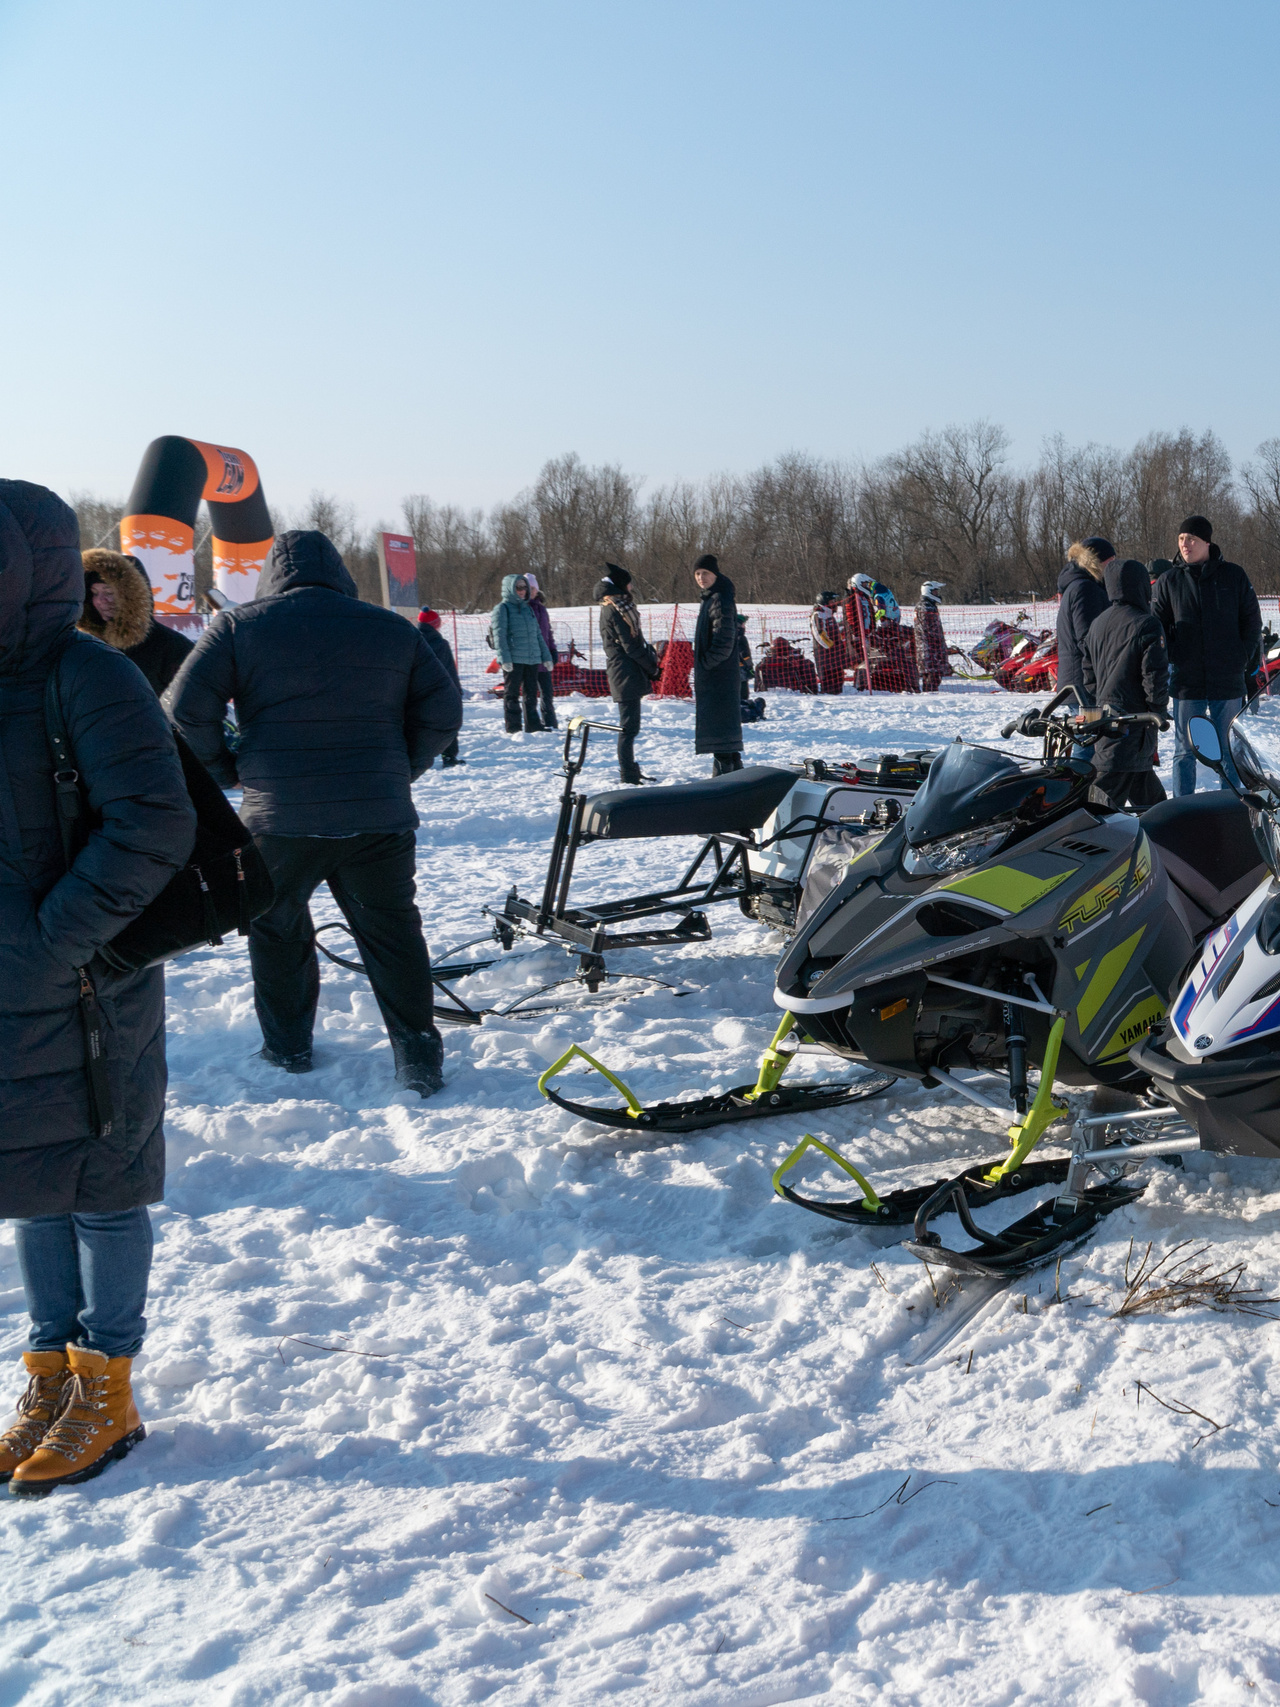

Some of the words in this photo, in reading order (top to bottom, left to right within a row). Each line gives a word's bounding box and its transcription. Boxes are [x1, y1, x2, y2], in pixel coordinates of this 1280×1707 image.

[864, 960, 923, 983] GENESIS
[935, 936, 991, 960] STROKE
[1119, 1011, 1163, 1045] YAMAHA
